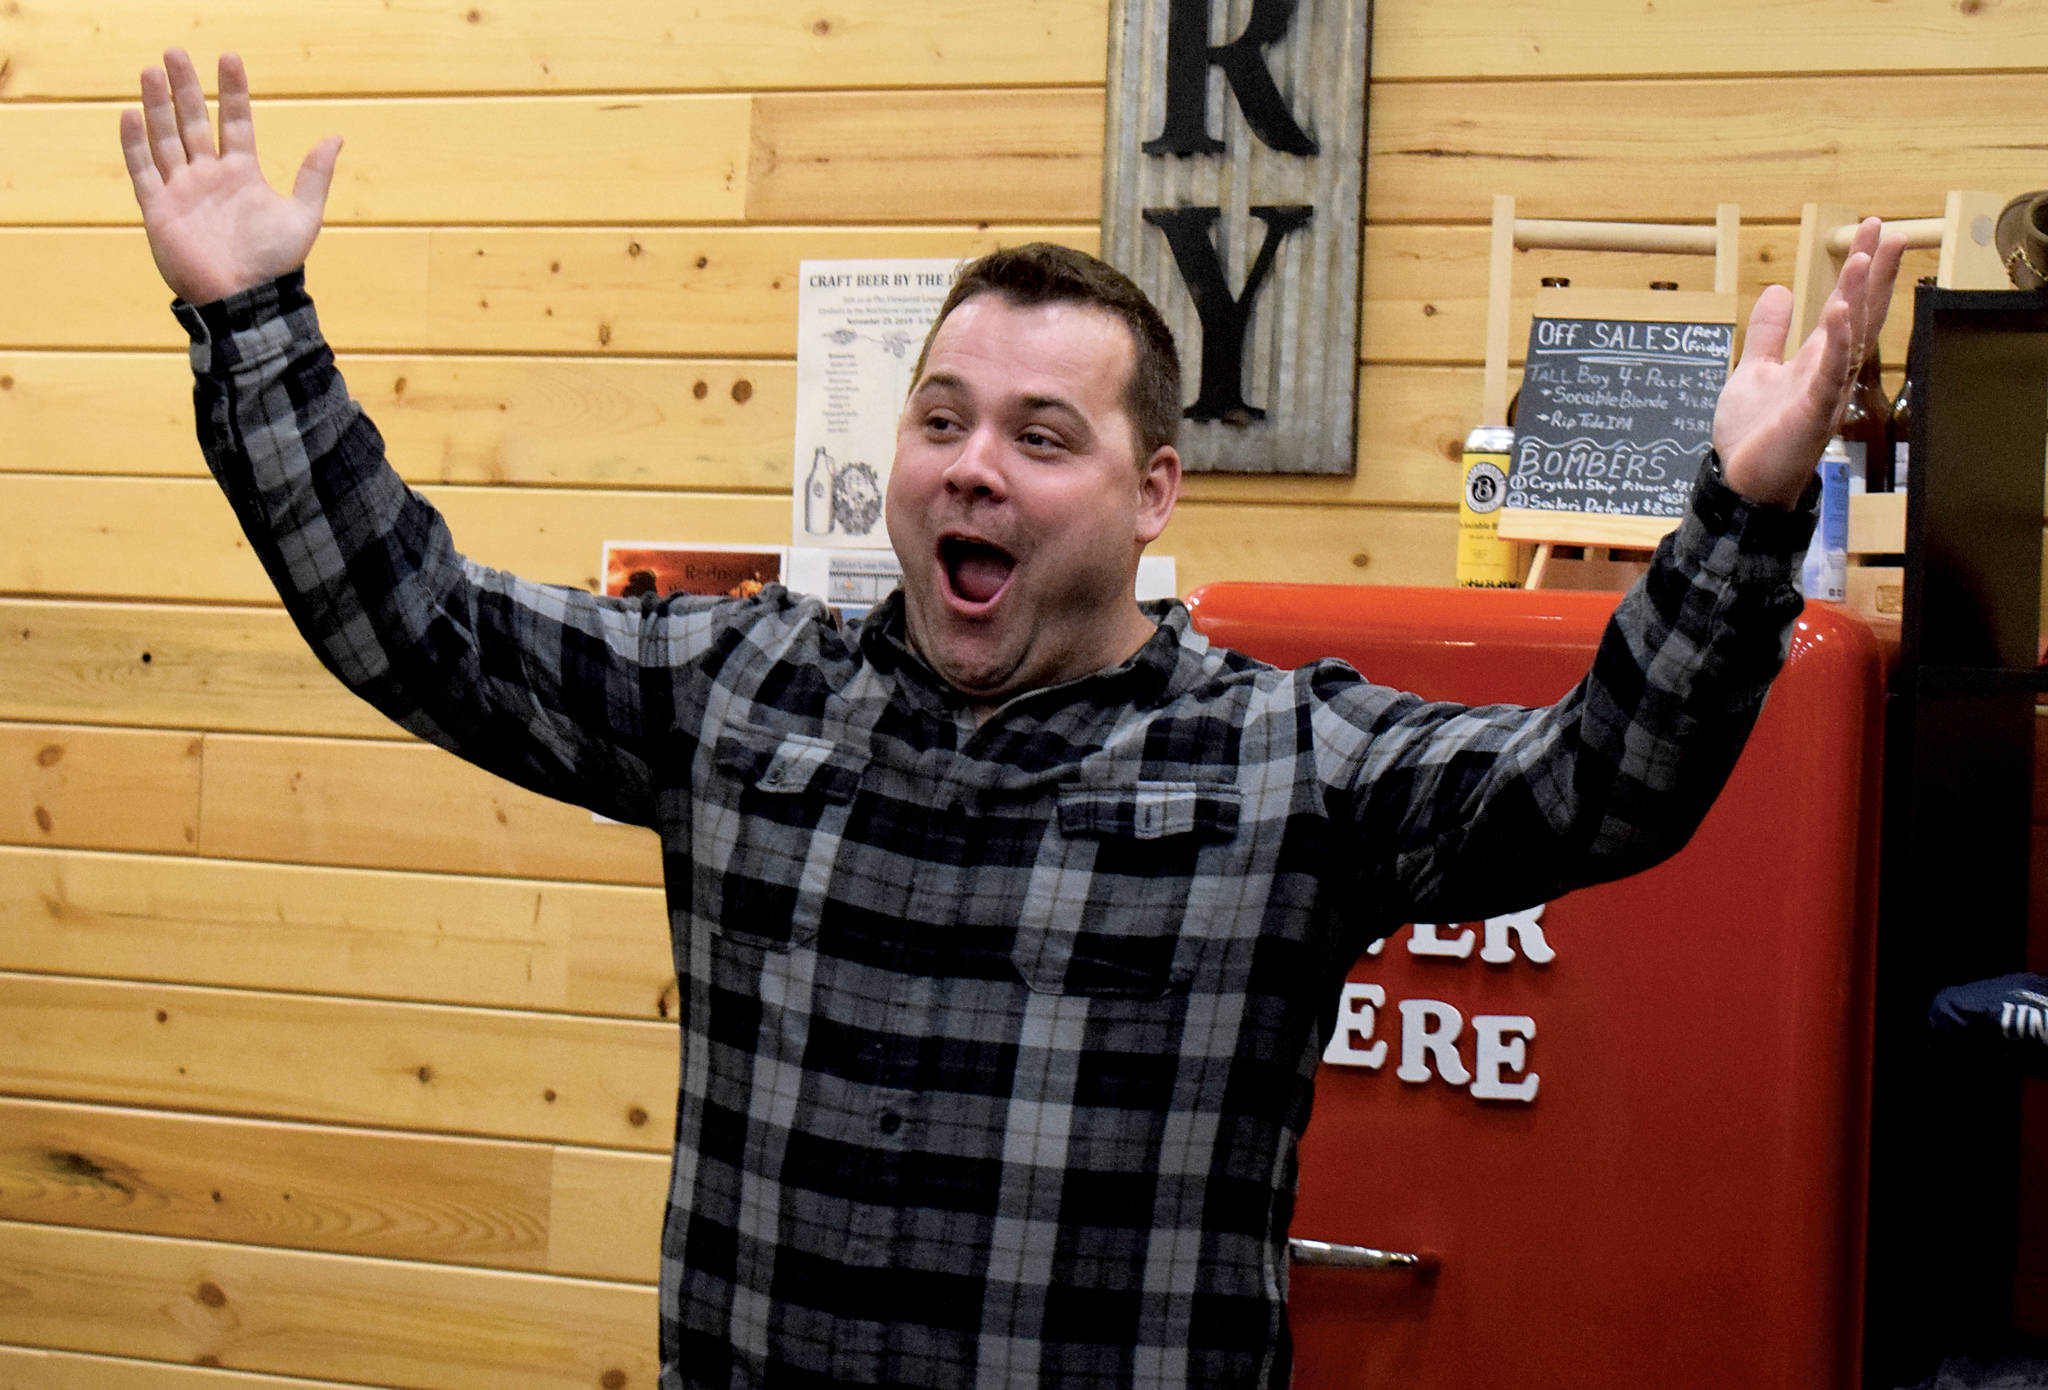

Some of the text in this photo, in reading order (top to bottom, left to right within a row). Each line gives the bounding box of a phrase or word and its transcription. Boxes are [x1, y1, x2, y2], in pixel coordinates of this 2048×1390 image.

[809, 273, 853, 288] CRAFT
[857, 273, 889, 288] BEER
[893, 273, 911, 287] BY
[916, 273, 943, 287] THE
[1538, 321, 1582, 346] OFF
[1589, 322, 1680, 351] SALES
[1577, 364, 1610, 390] Boy
[1550, 410, 1577, 430] Rip
[1517, 448, 1667, 480] BOMBERS
[1529, 475, 1583, 493] Crystal
[1585, 478, 1617, 494] Ship
[1584, 497, 1639, 515] Delight
